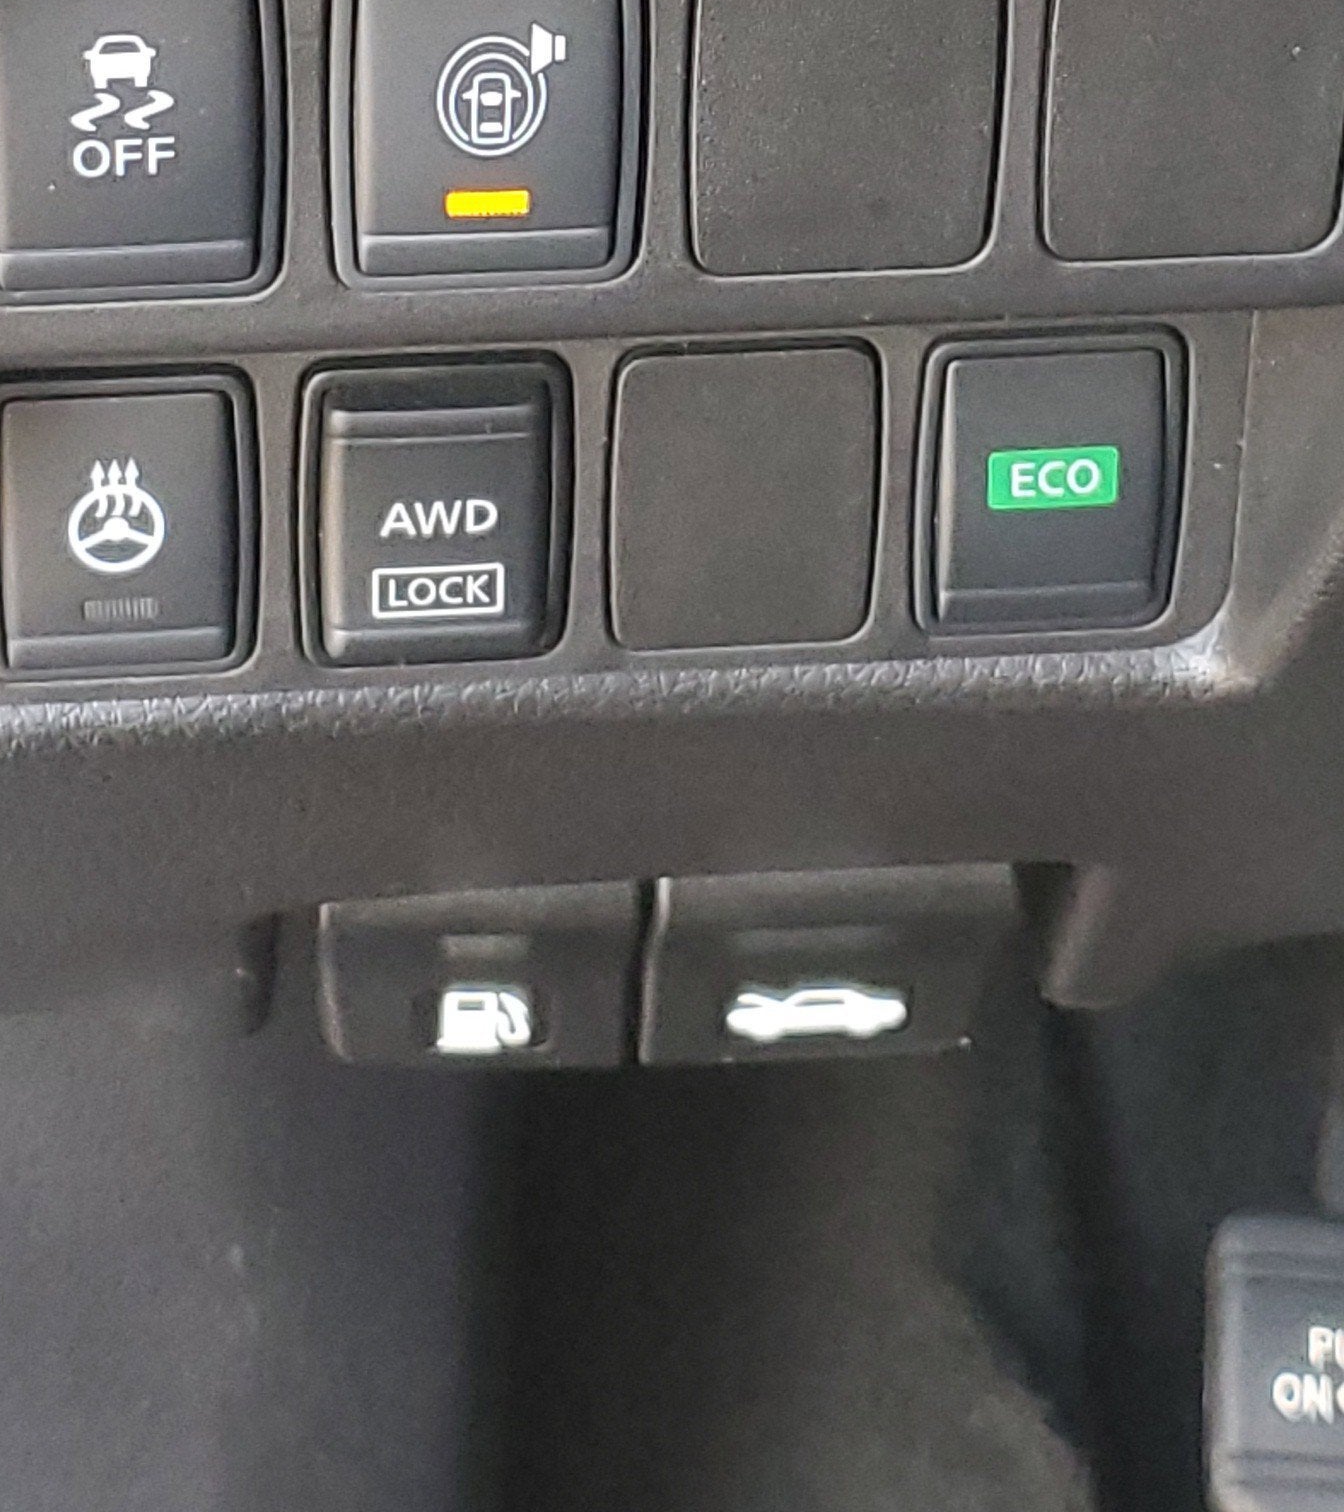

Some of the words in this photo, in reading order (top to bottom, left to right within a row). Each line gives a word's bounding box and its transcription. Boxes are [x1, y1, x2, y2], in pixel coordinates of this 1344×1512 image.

[72, 136, 176, 178] OFF
[1009, 458, 1101, 499] ECO
[379, 498, 498, 539] AWD
[386, 574, 492, 608] LOCK
